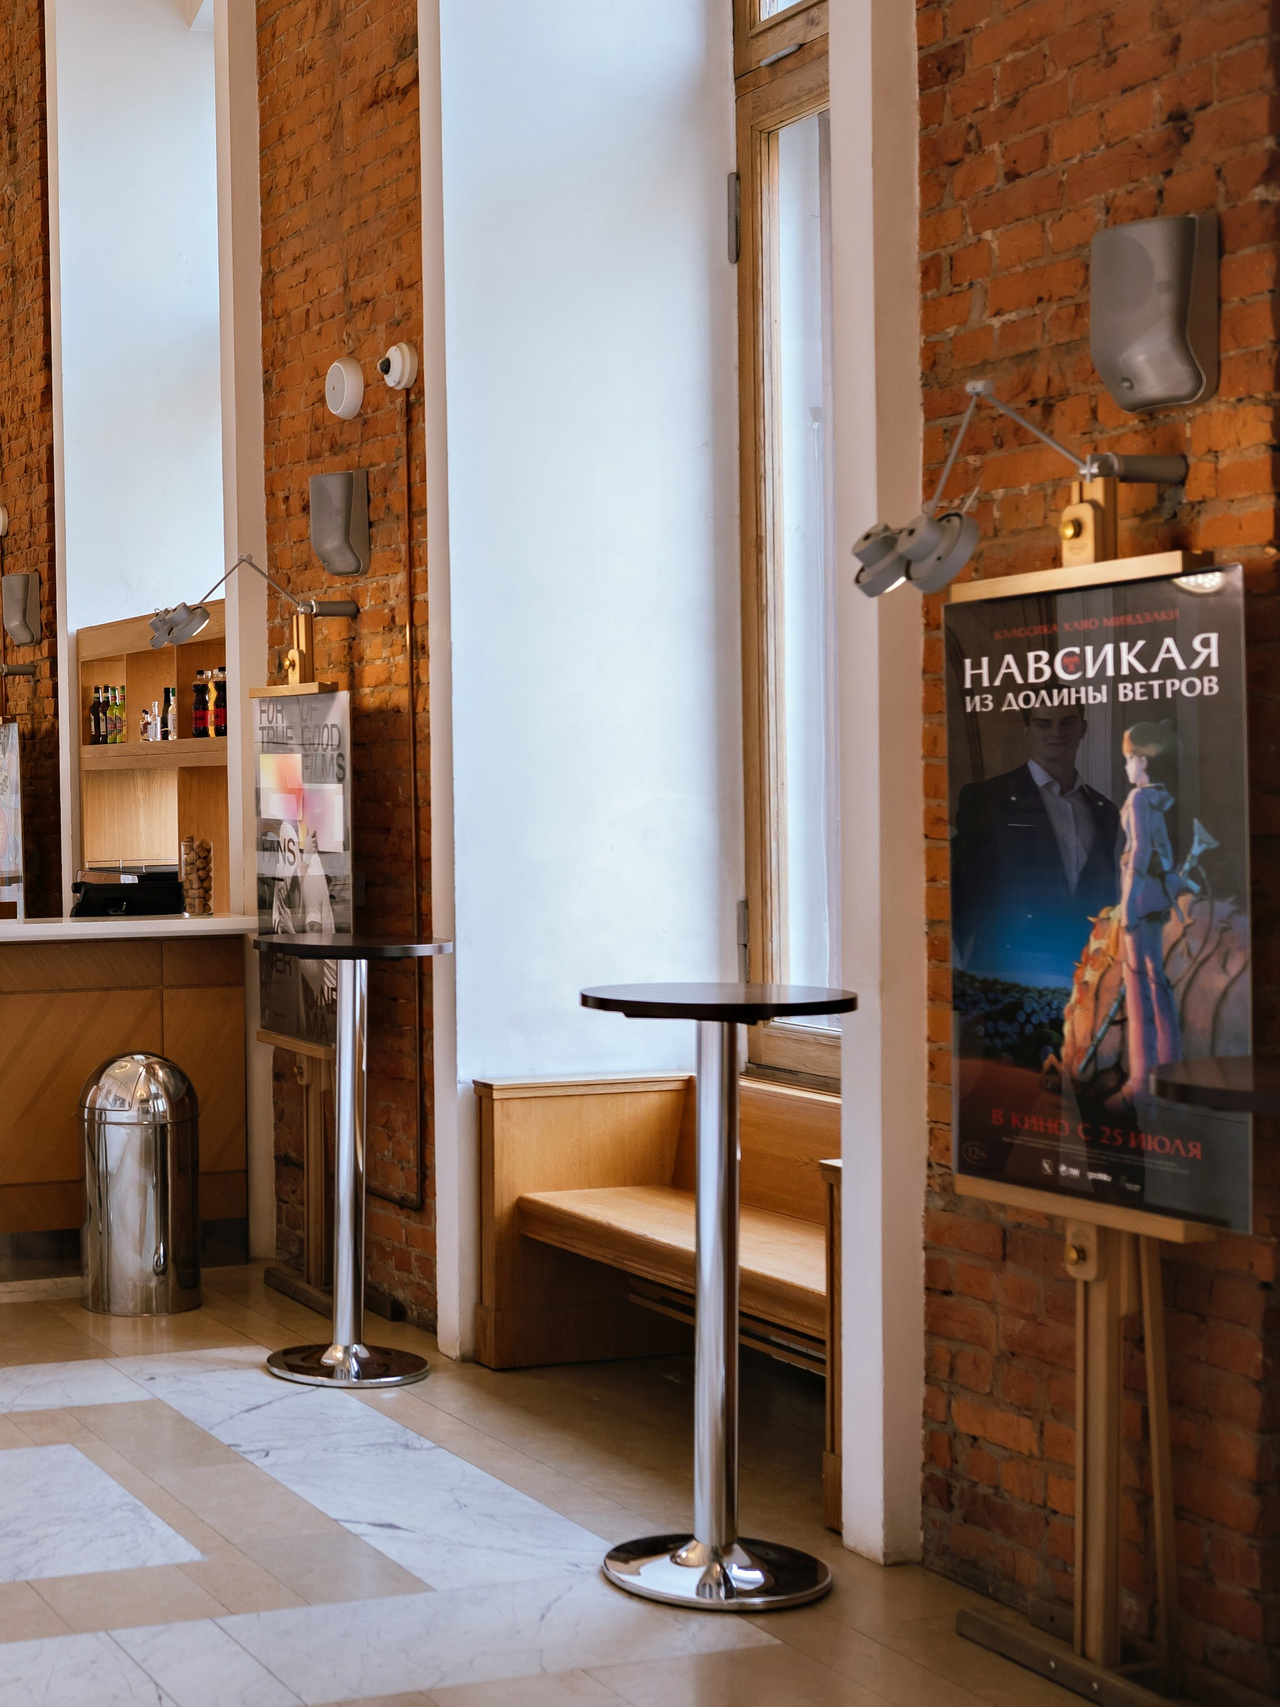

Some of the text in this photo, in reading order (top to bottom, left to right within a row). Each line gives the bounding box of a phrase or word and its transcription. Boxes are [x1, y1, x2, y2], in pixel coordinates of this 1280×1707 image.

[1062, 617, 1099, 633] ХАЯО
[963, 632, 1220, 689] НАВСИКАЯ
[965, 675, 1220, 713] ИЗ ДОЛИНЫ ВЕТРОВ
[259, 699, 284, 725] FOR
[258, 726, 294, 753] TRUE
[301, 723, 342, 753] GOOD
[303, 752, 346, 783] FILMS
[262, 837, 296, 866] FANS
[991, 1108, 1005, 1126] В
[1010, 1111, 1070, 1137] КИНО
[1077, 1123, 1092, 1141] С
[1100, 1126, 1123, 1146] 25
[1128, 1131, 1202, 1160] ИЮЛЯ
